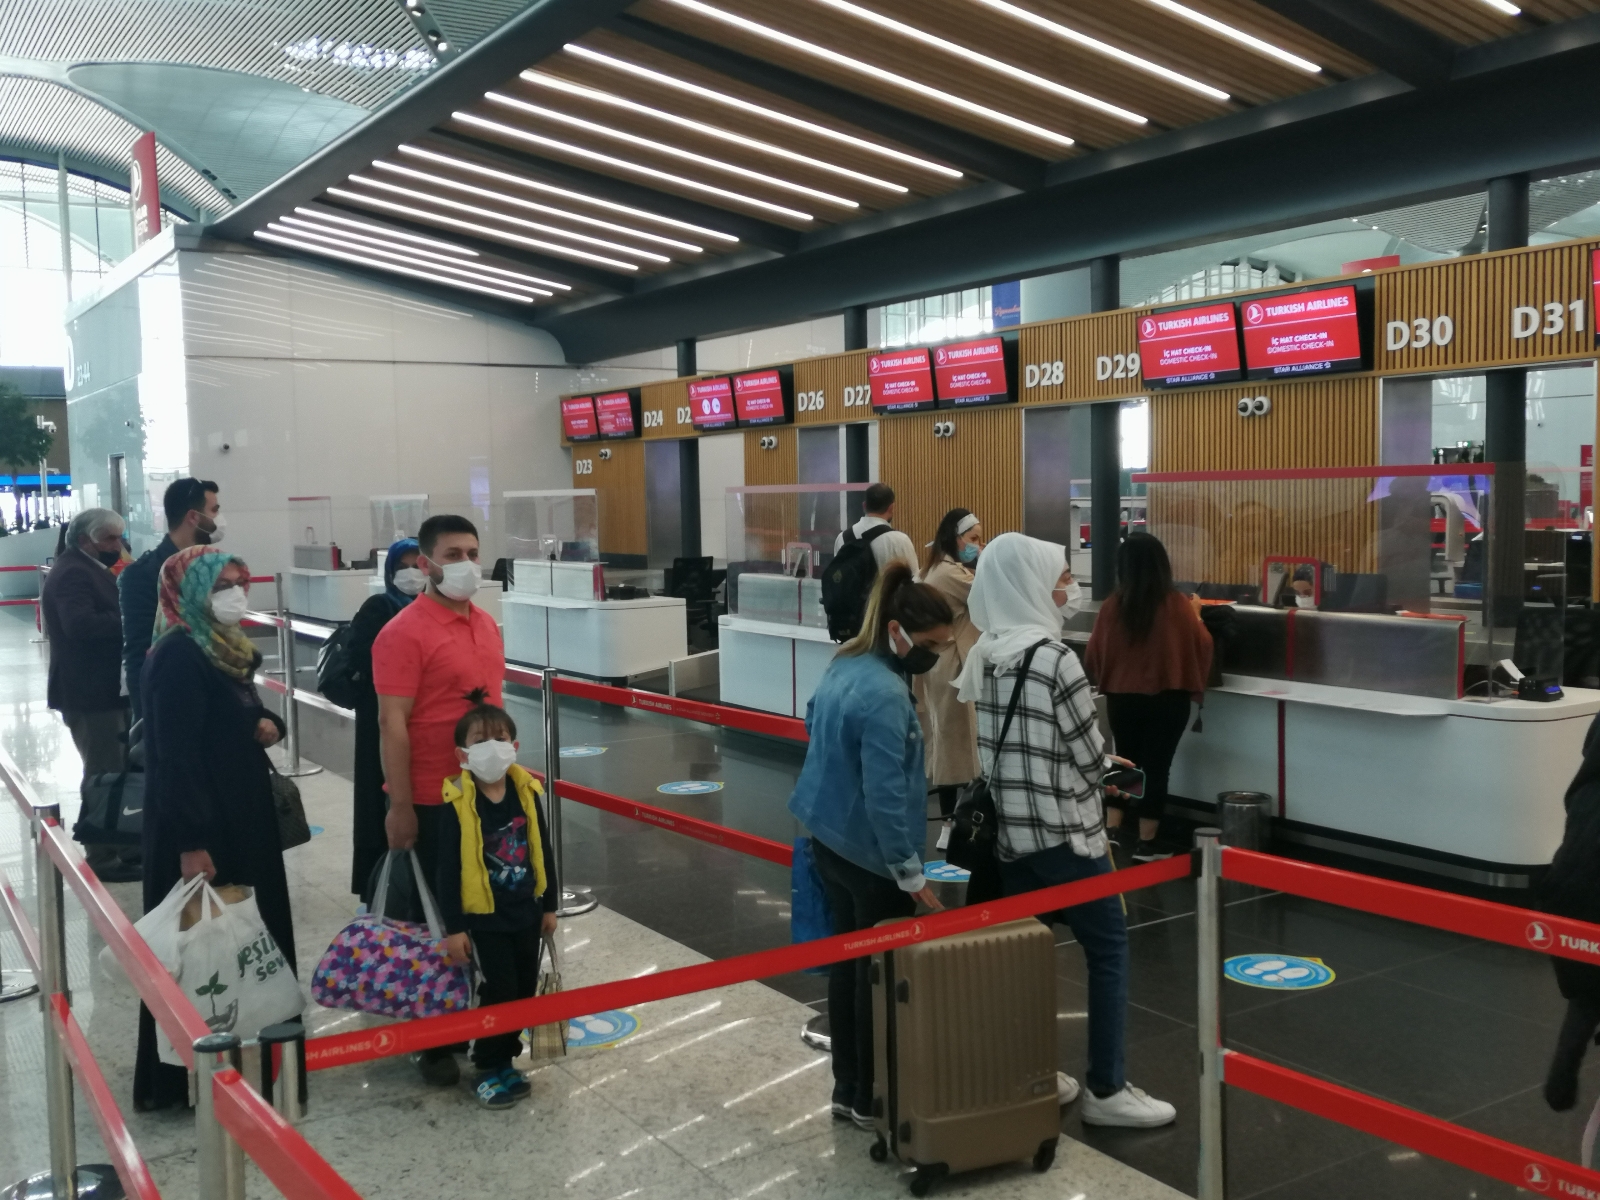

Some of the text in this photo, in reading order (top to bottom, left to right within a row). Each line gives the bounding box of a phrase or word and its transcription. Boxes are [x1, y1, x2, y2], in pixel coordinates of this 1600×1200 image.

[1265, 296, 1349, 317] TURKISH AIRLINES
[1158, 312, 1229, 331] TURKISH AIRLINES
[1513, 299, 1584, 339] D31
[1280, 336, 1293, 344] HAT
[1294, 332, 1327, 342] CHECK-IN
[1386, 315, 1453, 351] D30
[948, 345, 998, 359] TURKISH AIRLINES
[1182, 345, 1212, 354] CHECK-IN
[1267, 340, 1334, 354] DOMESTIC CHECK-IN
[880, 355, 926, 368] TURKISH AIRLINES
[1096, 352, 1140, 380] D29
[1160, 352, 1217, 365] DOMESTIC CHECK-IN
[1025, 361, 1064, 388] D28
[1181, 374, 1208, 382] ALLIANCE
[1273, 364, 1323, 374] STAR ALLIANCE
[743, 376, 777, 387] TURKISH AIRLINES
[797, 390, 825, 412] D26
[844, 384, 871, 407] D27
[643, 410, 664, 428] D24
[677, 406, 693, 424] D2
[576, 459, 593, 475] D23
[843, 929, 911, 951] TURKISH AIRLINES
[320, 1041, 371, 1059] AIRLINES
